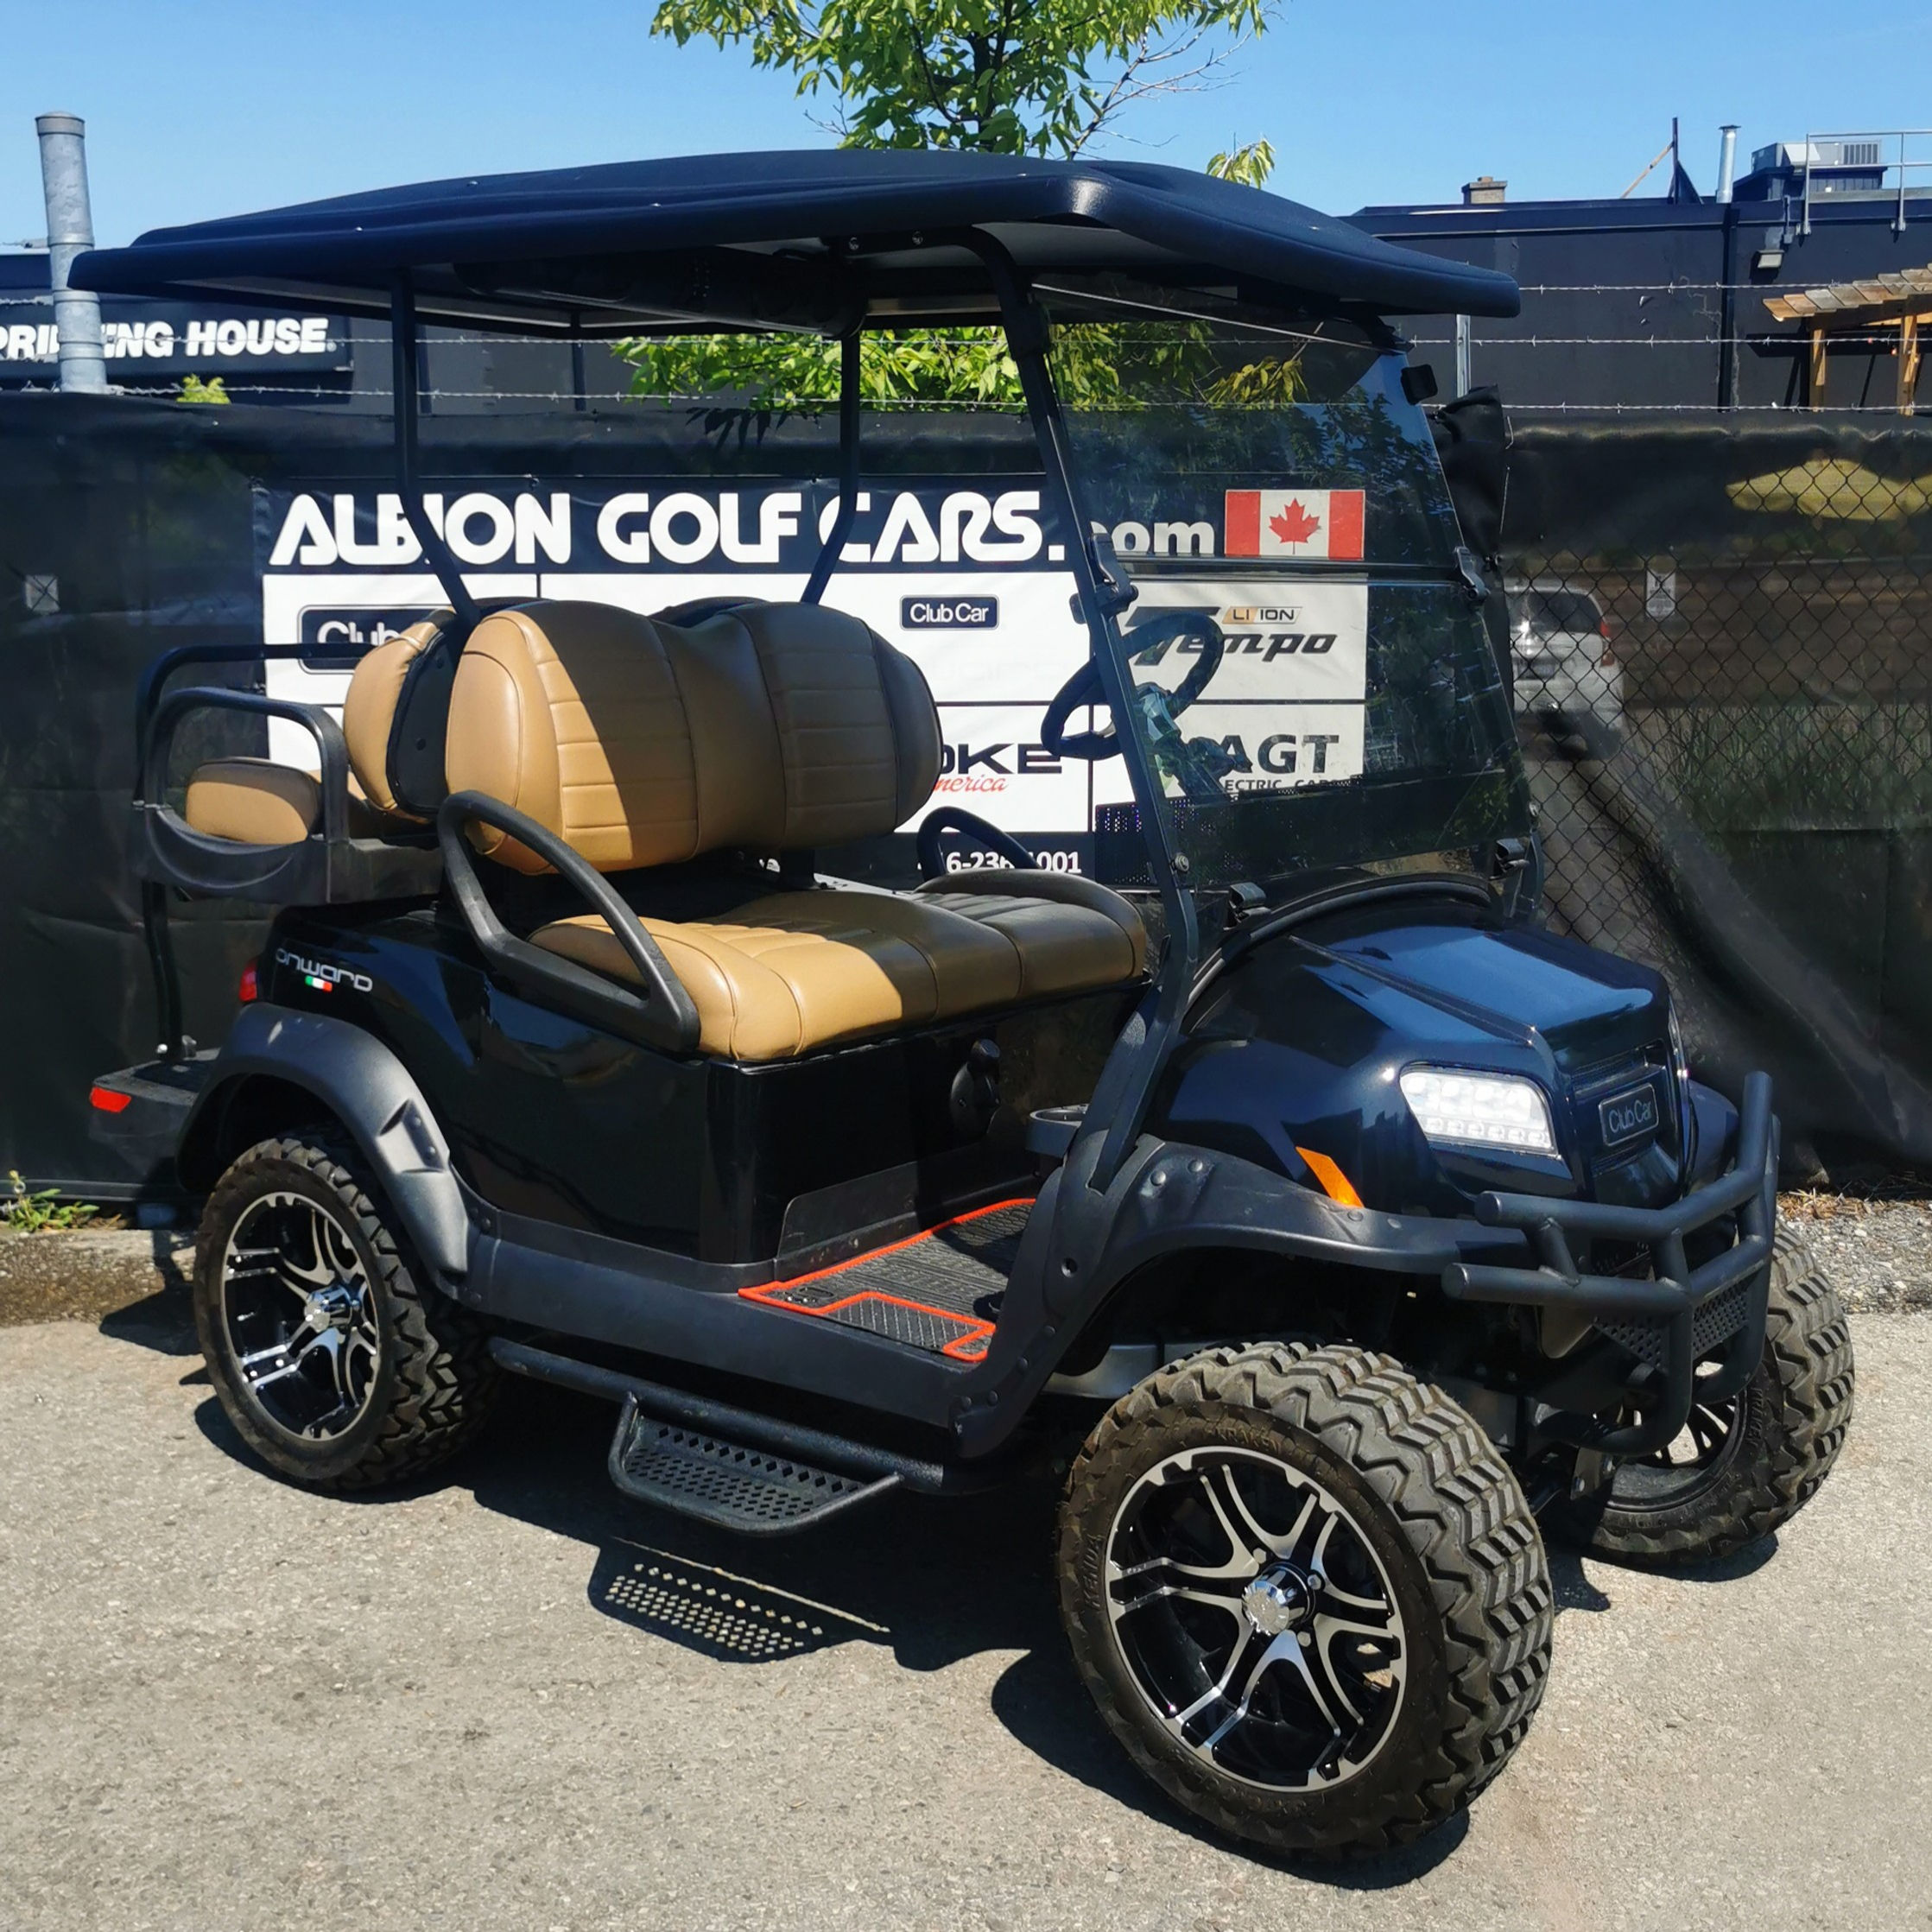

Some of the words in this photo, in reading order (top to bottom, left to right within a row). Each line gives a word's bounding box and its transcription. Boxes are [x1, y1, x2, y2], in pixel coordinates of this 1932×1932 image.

[0, 322, 174, 360] RIING
[597, 492, 801, 564] GOLF
[1090, 521, 1215, 557] om
[909, 603, 953, 623] Club
[954, 602, 989, 623] Car
[1260, 609, 1295, 621] ION
[1219, 734, 1340, 774] AGT
[1608, 1106, 1635, 1133] Club
[1634, 1099, 1651, 1123] Car
